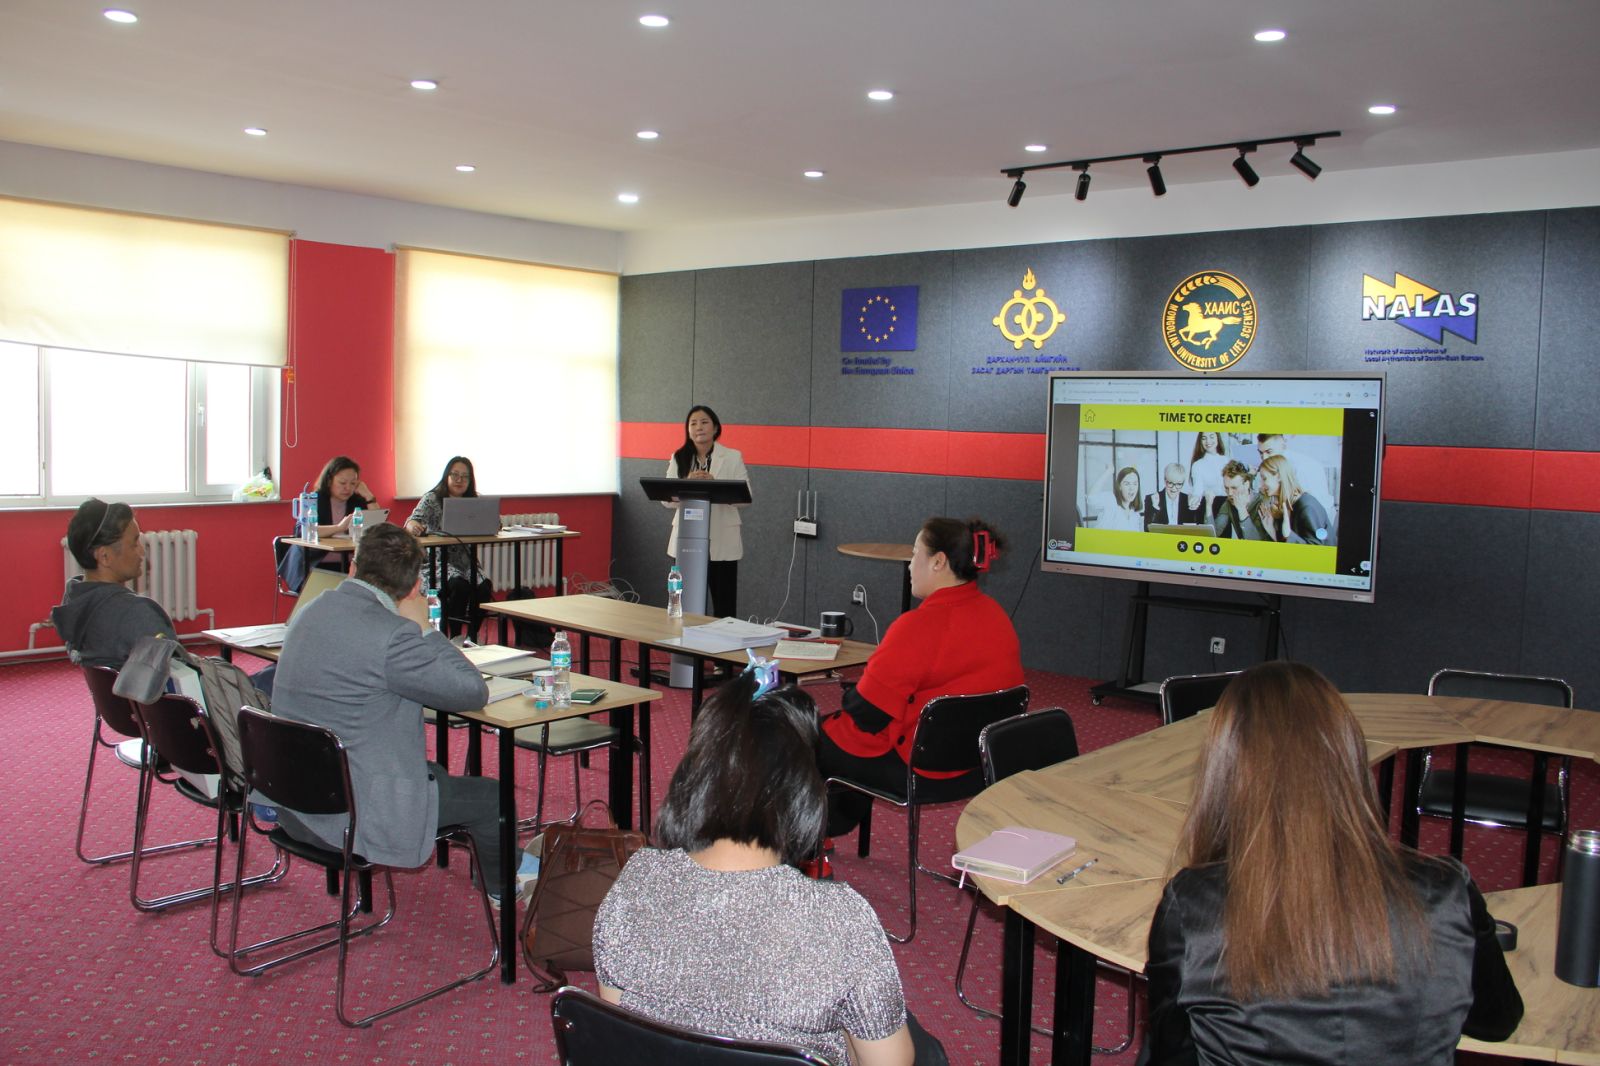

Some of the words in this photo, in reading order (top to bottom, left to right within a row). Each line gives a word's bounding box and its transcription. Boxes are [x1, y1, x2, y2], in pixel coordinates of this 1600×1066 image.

[1204, 301, 1240, 315] ХААИС
[1362, 293, 1477, 319] NALAS
[1166, 303, 1180, 348] MONGOLIAN
[1176, 346, 1217, 368] UNIVERSITY
[1219, 352, 1230, 364] OF
[1229, 339, 1246, 357] LIFE
[1240, 300, 1253, 339] SCIENCES
[1159, 412, 1186, 423] TIME
[1187, 412, 1203, 423] TO
[1205, 413, 1251, 424] CREATE!
